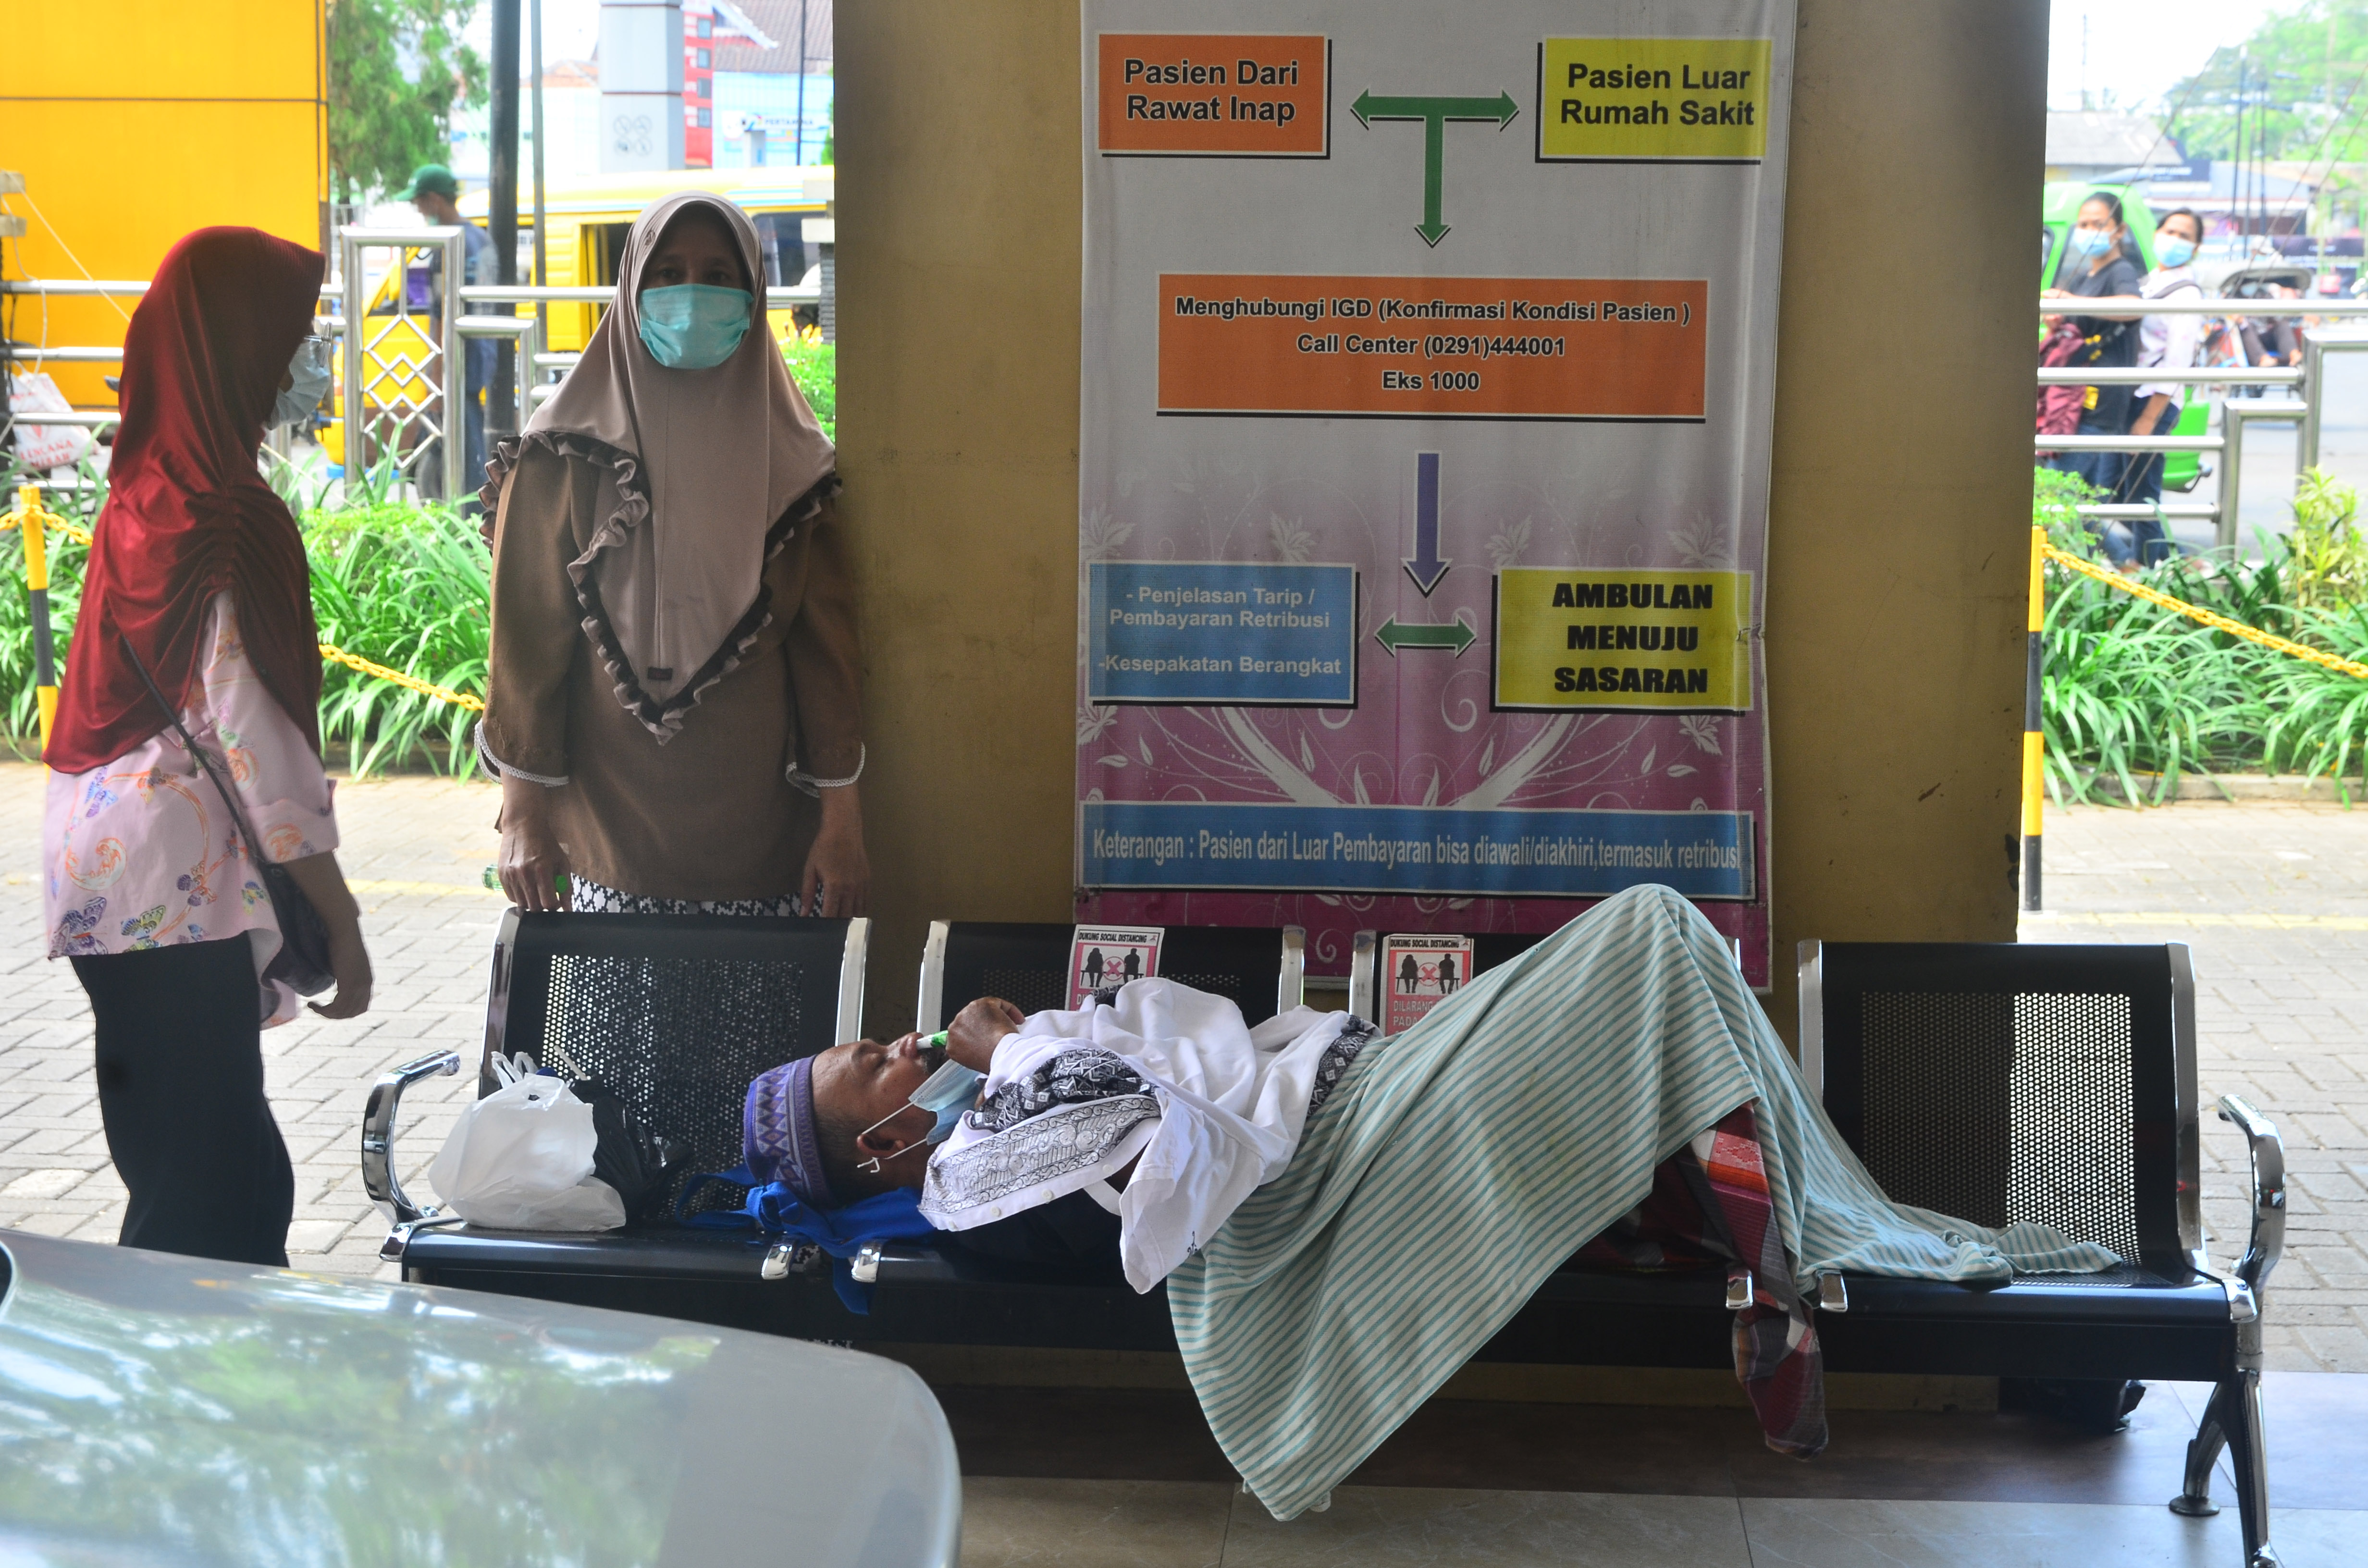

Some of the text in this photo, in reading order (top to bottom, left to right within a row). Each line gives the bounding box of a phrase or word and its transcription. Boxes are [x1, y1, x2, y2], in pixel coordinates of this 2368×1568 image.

[1124, 58, 1298, 86] Pasien Dari
[1568, 63, 1751, 90] Pasien Luar
[1127, 94, 1296, 128] Rawat Inap
[1560, 98, 1755, 126] Rumah Sakit
[1175, 296, 1325, 321] Menghubungi
[1332, 299, 1372, 318] IGD
[1379, 299, 1505, 322] (Konfirmasi
[1512, 301, 1596, 320] Kondisi
[1603, 302, 1676, 321] Pasien
[1297, 334, 1565, 360] Call Center (0291)444001
[1382, 371, 1480, 391] Eks 1000
[1139, 587, 1246, 607] Penjelasan
[1254, 588, 1303, 608] Tarip
[1308, 589, 1315, 605] /
[1552, 583, 1713, 609] AMBULAN
[1110, 609, 1330, 629] Pembayaran Retribusi
[1567, 625, 1698, 651] MENUJU
[1240, 656, 1341, 677] Berangkat
[1554, 667, 1707, 693] SASARAN
[1094, 829, 1184, 866] Keterangan
[1199, 830, 1252, 859] Pasien
[1257, 831, 1288, 860] dari
[1293, 831, 1329, 860] Luar
[1333, 832, 1431, 870] Pembayaran
[1437, 834, 1469, 864] bisa
[1078, 932, 1147, 943] DUKUNG SOCIAL DISTANCING
[1390, 939, 1411, 947] DUKUNG
[1431, 940, 1459, 948] DISTANCING
[1394, 1001, 1433, 1012] DILARANG
[1394, 1017, 1417, 1026] PADA
